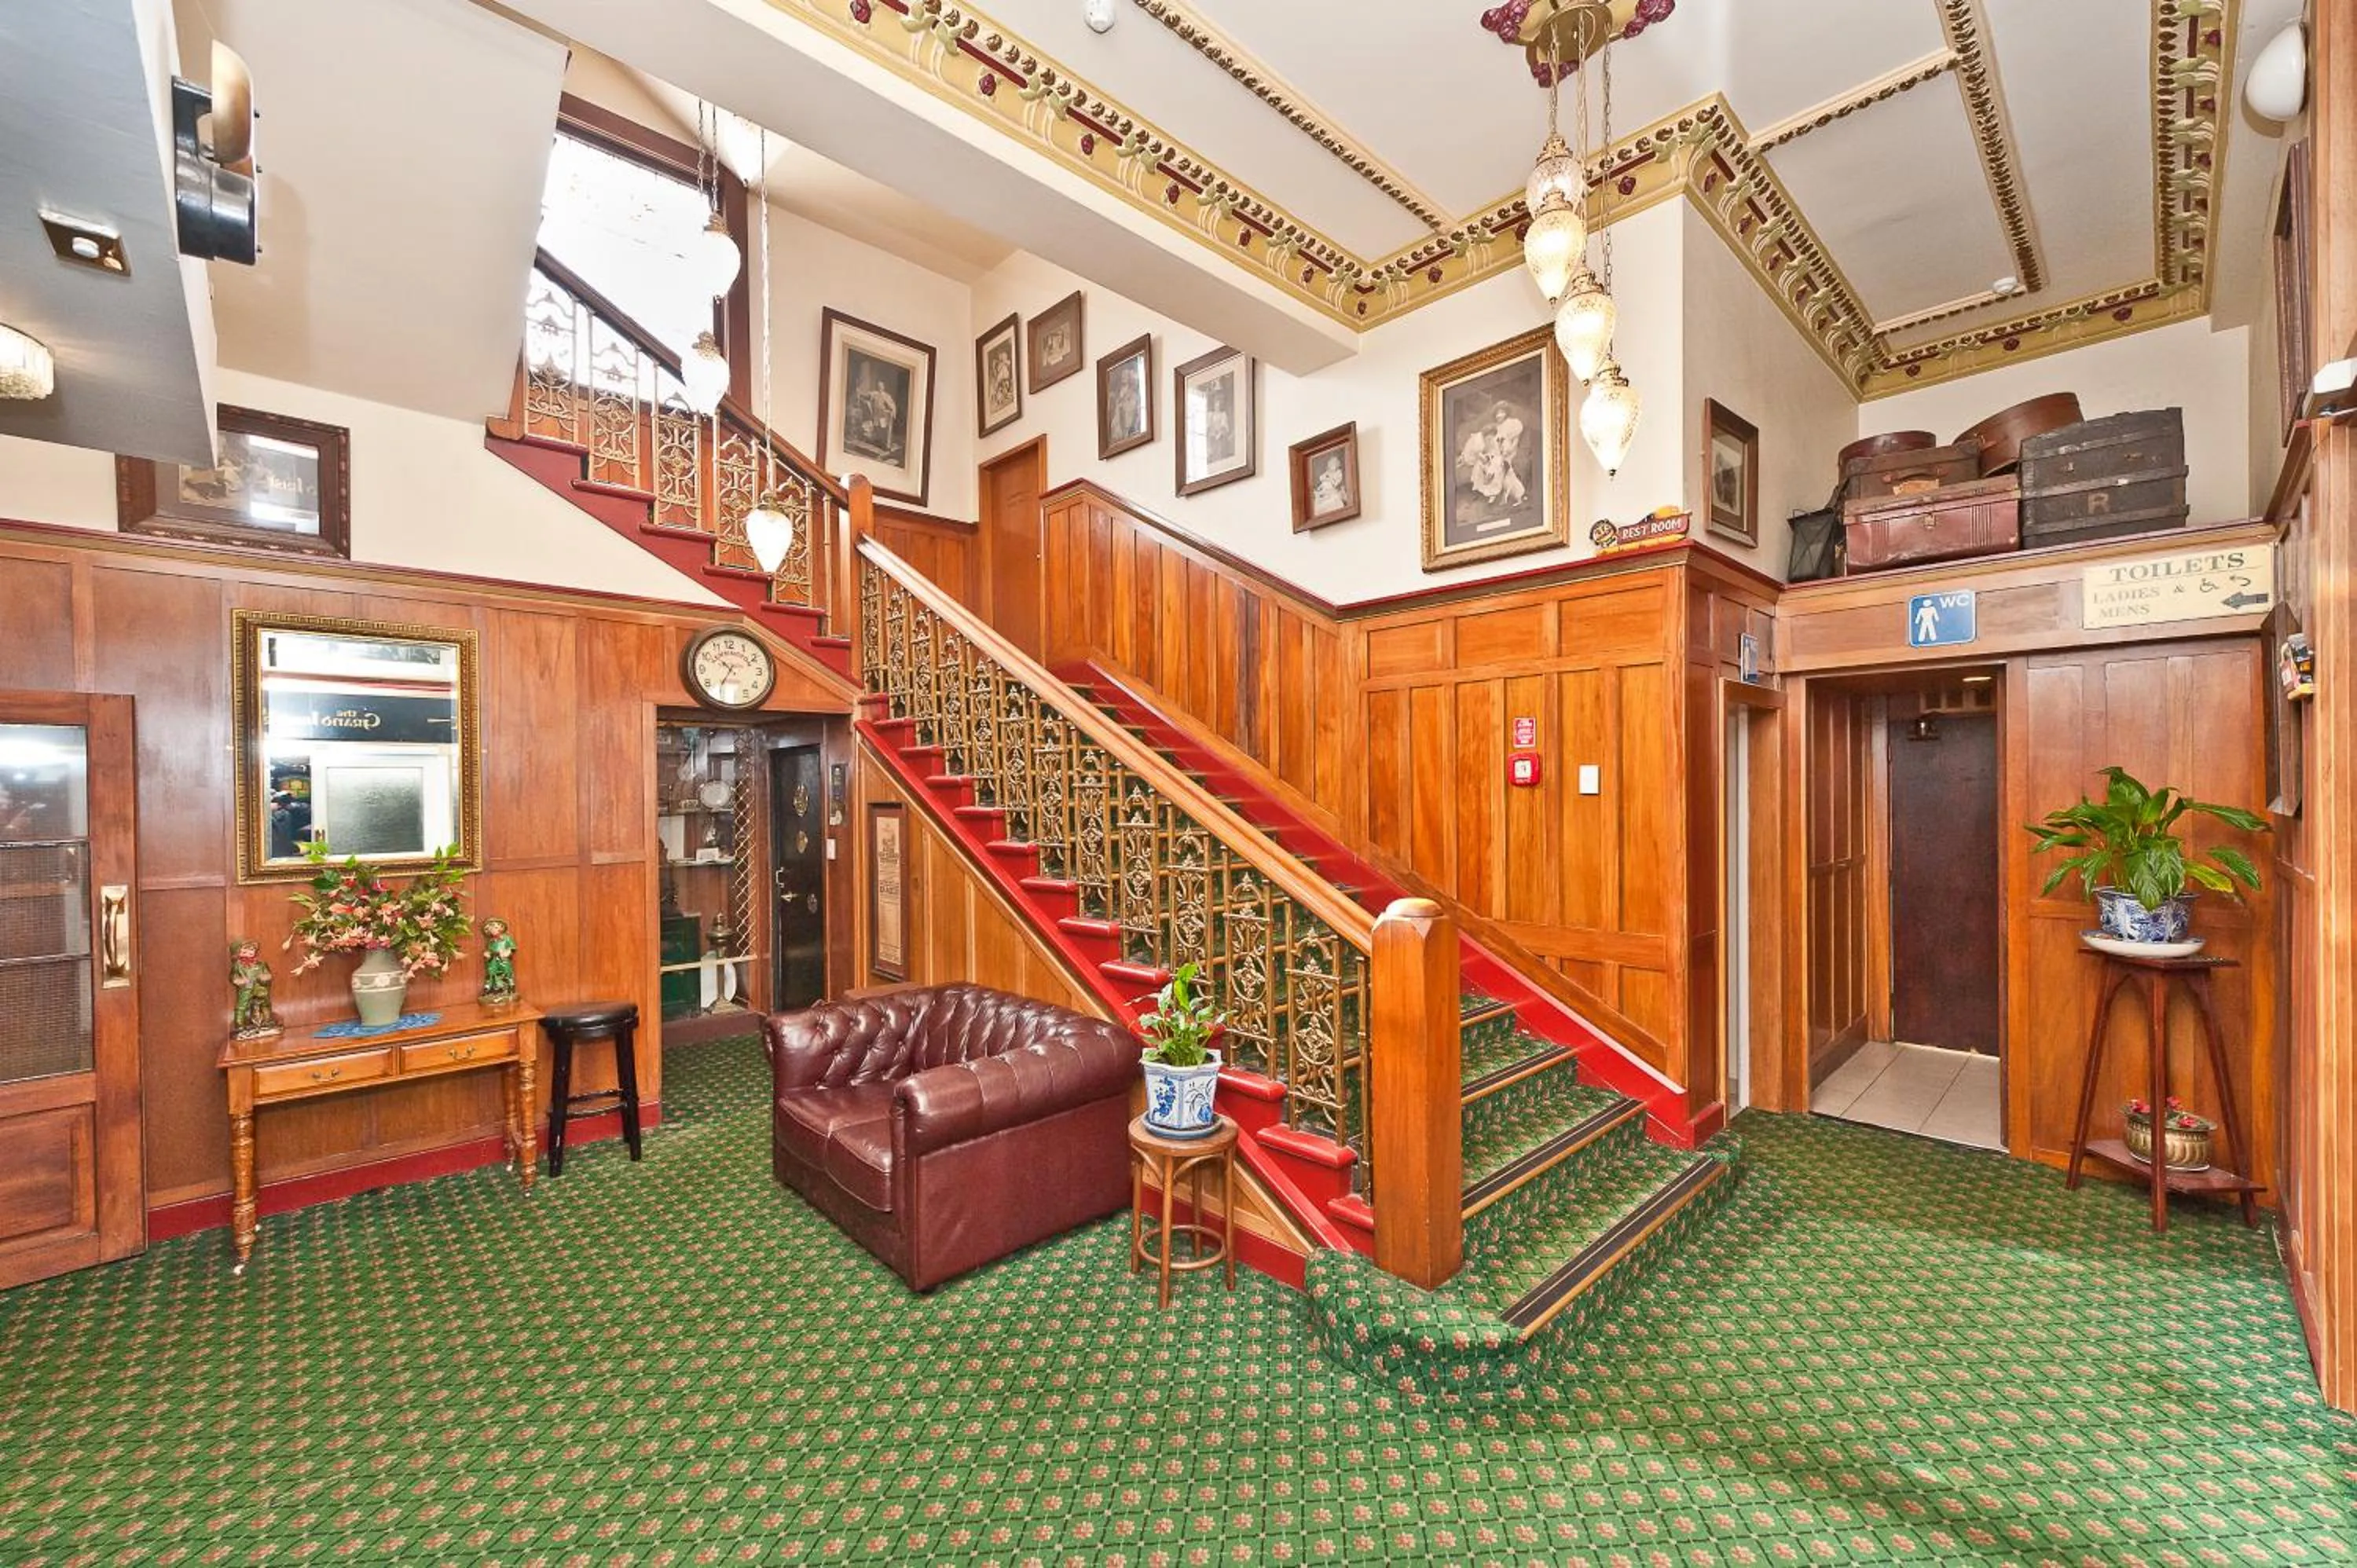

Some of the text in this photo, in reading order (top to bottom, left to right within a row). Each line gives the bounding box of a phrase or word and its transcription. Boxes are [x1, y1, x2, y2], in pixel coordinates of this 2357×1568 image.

[1622, 518, 1681, 540] REST ROOM
[2110, 552, 2245, 582] TOILETS
[2093, 584, 2185, 604] LADIES &
[1938, 594, 1970, 609] WC
[2099, 604, 2150, 618] MENS
[724, 640, 735, 650] 12
[750, 653, 757, 662] 2
[755, 667, 763, 676] 3
